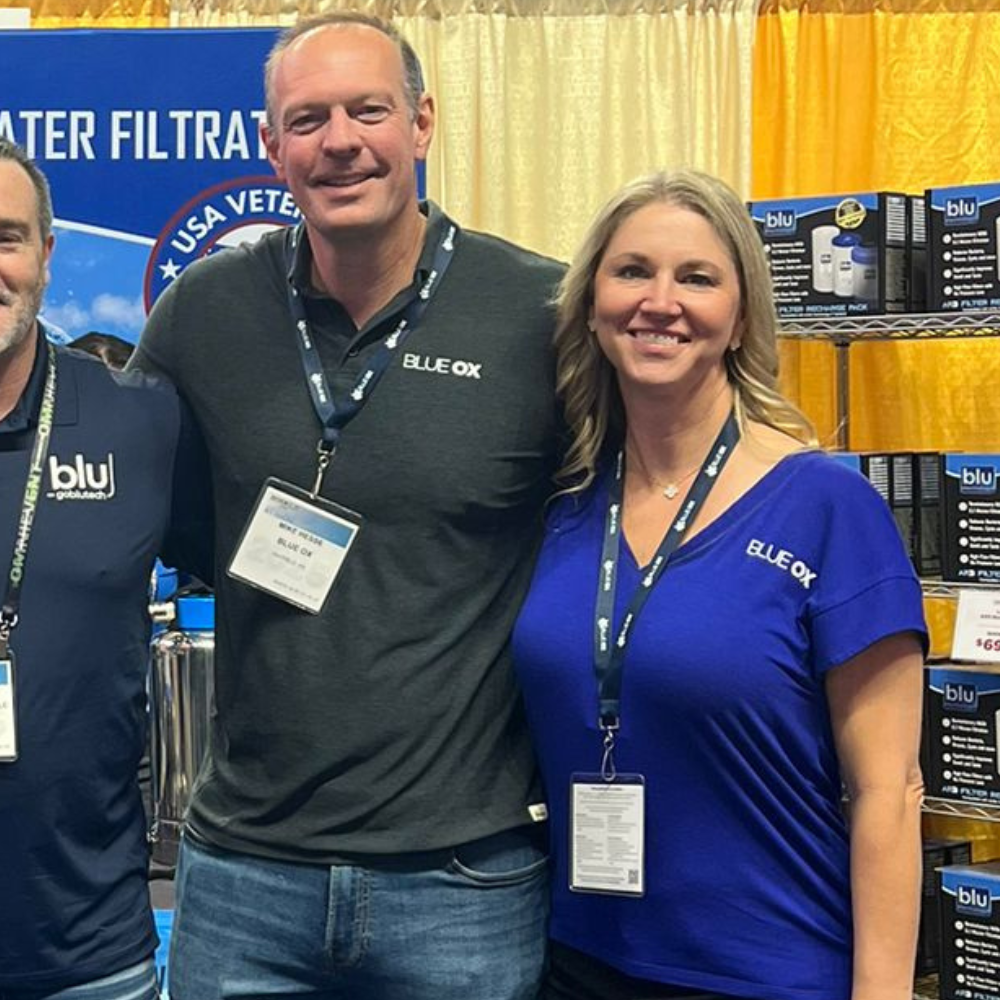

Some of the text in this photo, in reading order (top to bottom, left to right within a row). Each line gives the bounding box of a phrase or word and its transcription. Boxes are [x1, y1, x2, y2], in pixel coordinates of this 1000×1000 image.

[110, 110, 269, 160] FILTRAT
[766, 211, 793, 228] blu
[946, 199, 975, 217] blu
[170, 204, 227, 254] USA
[402, 353, 482, 379] BLUE OX
[48, 453, 109, 491] blu
[962, 467, 992, 486] blu
[745, 538, 818, 589] BLUE OX
[945, 683, 974, 702] blu
[958, 886, 988, 907] blu
